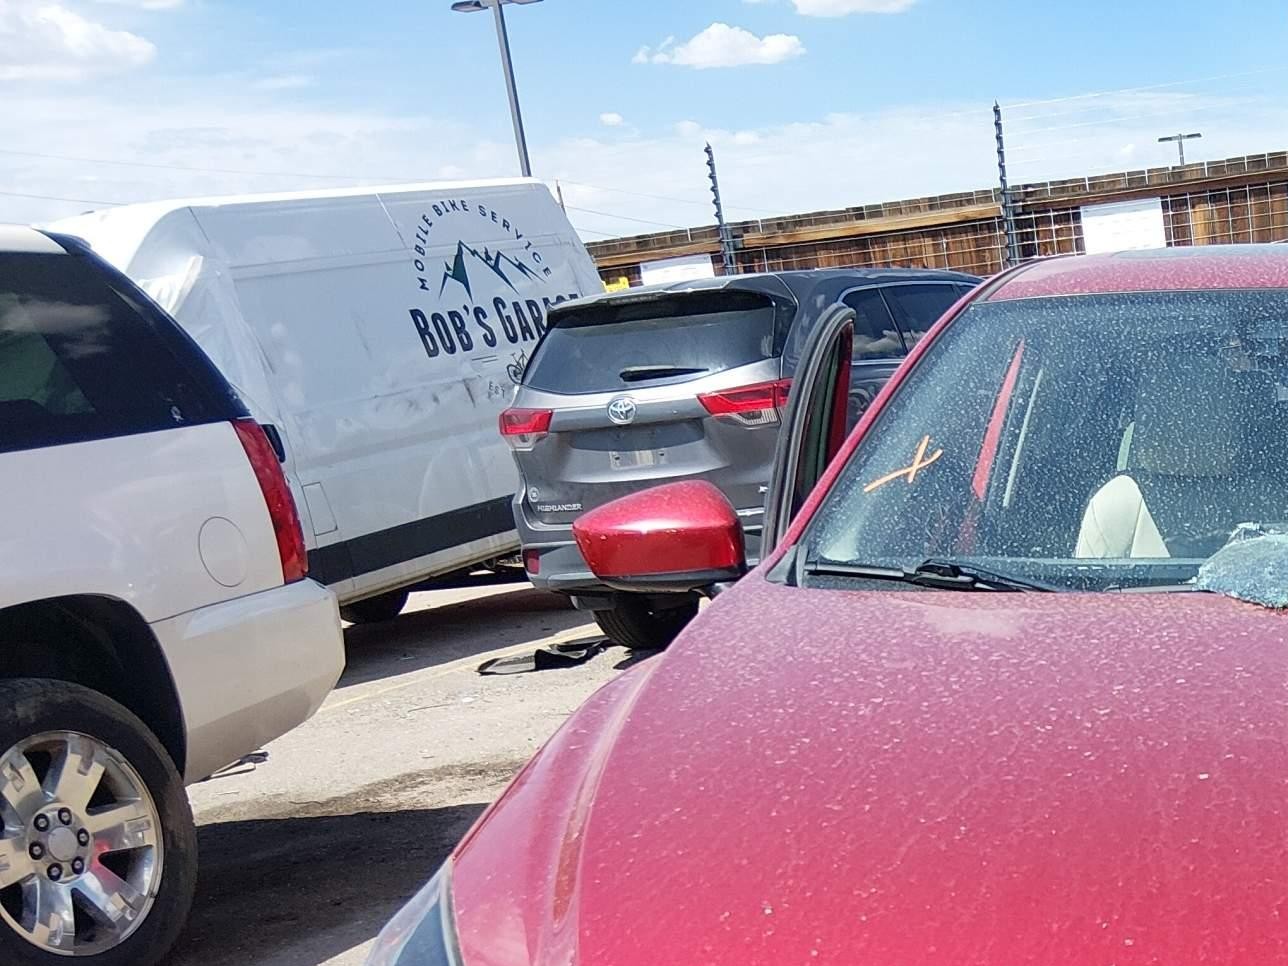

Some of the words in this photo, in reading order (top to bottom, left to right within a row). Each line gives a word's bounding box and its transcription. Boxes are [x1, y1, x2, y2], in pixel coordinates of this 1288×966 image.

[414, 214, 433, 291] MOBILE
[432, 199, 469, 217] BIKE
[478, 204, 551, 277] SERVICE
[409, 304, 497, 358] BOB'S
[493, 293, 578, 344] GAR
